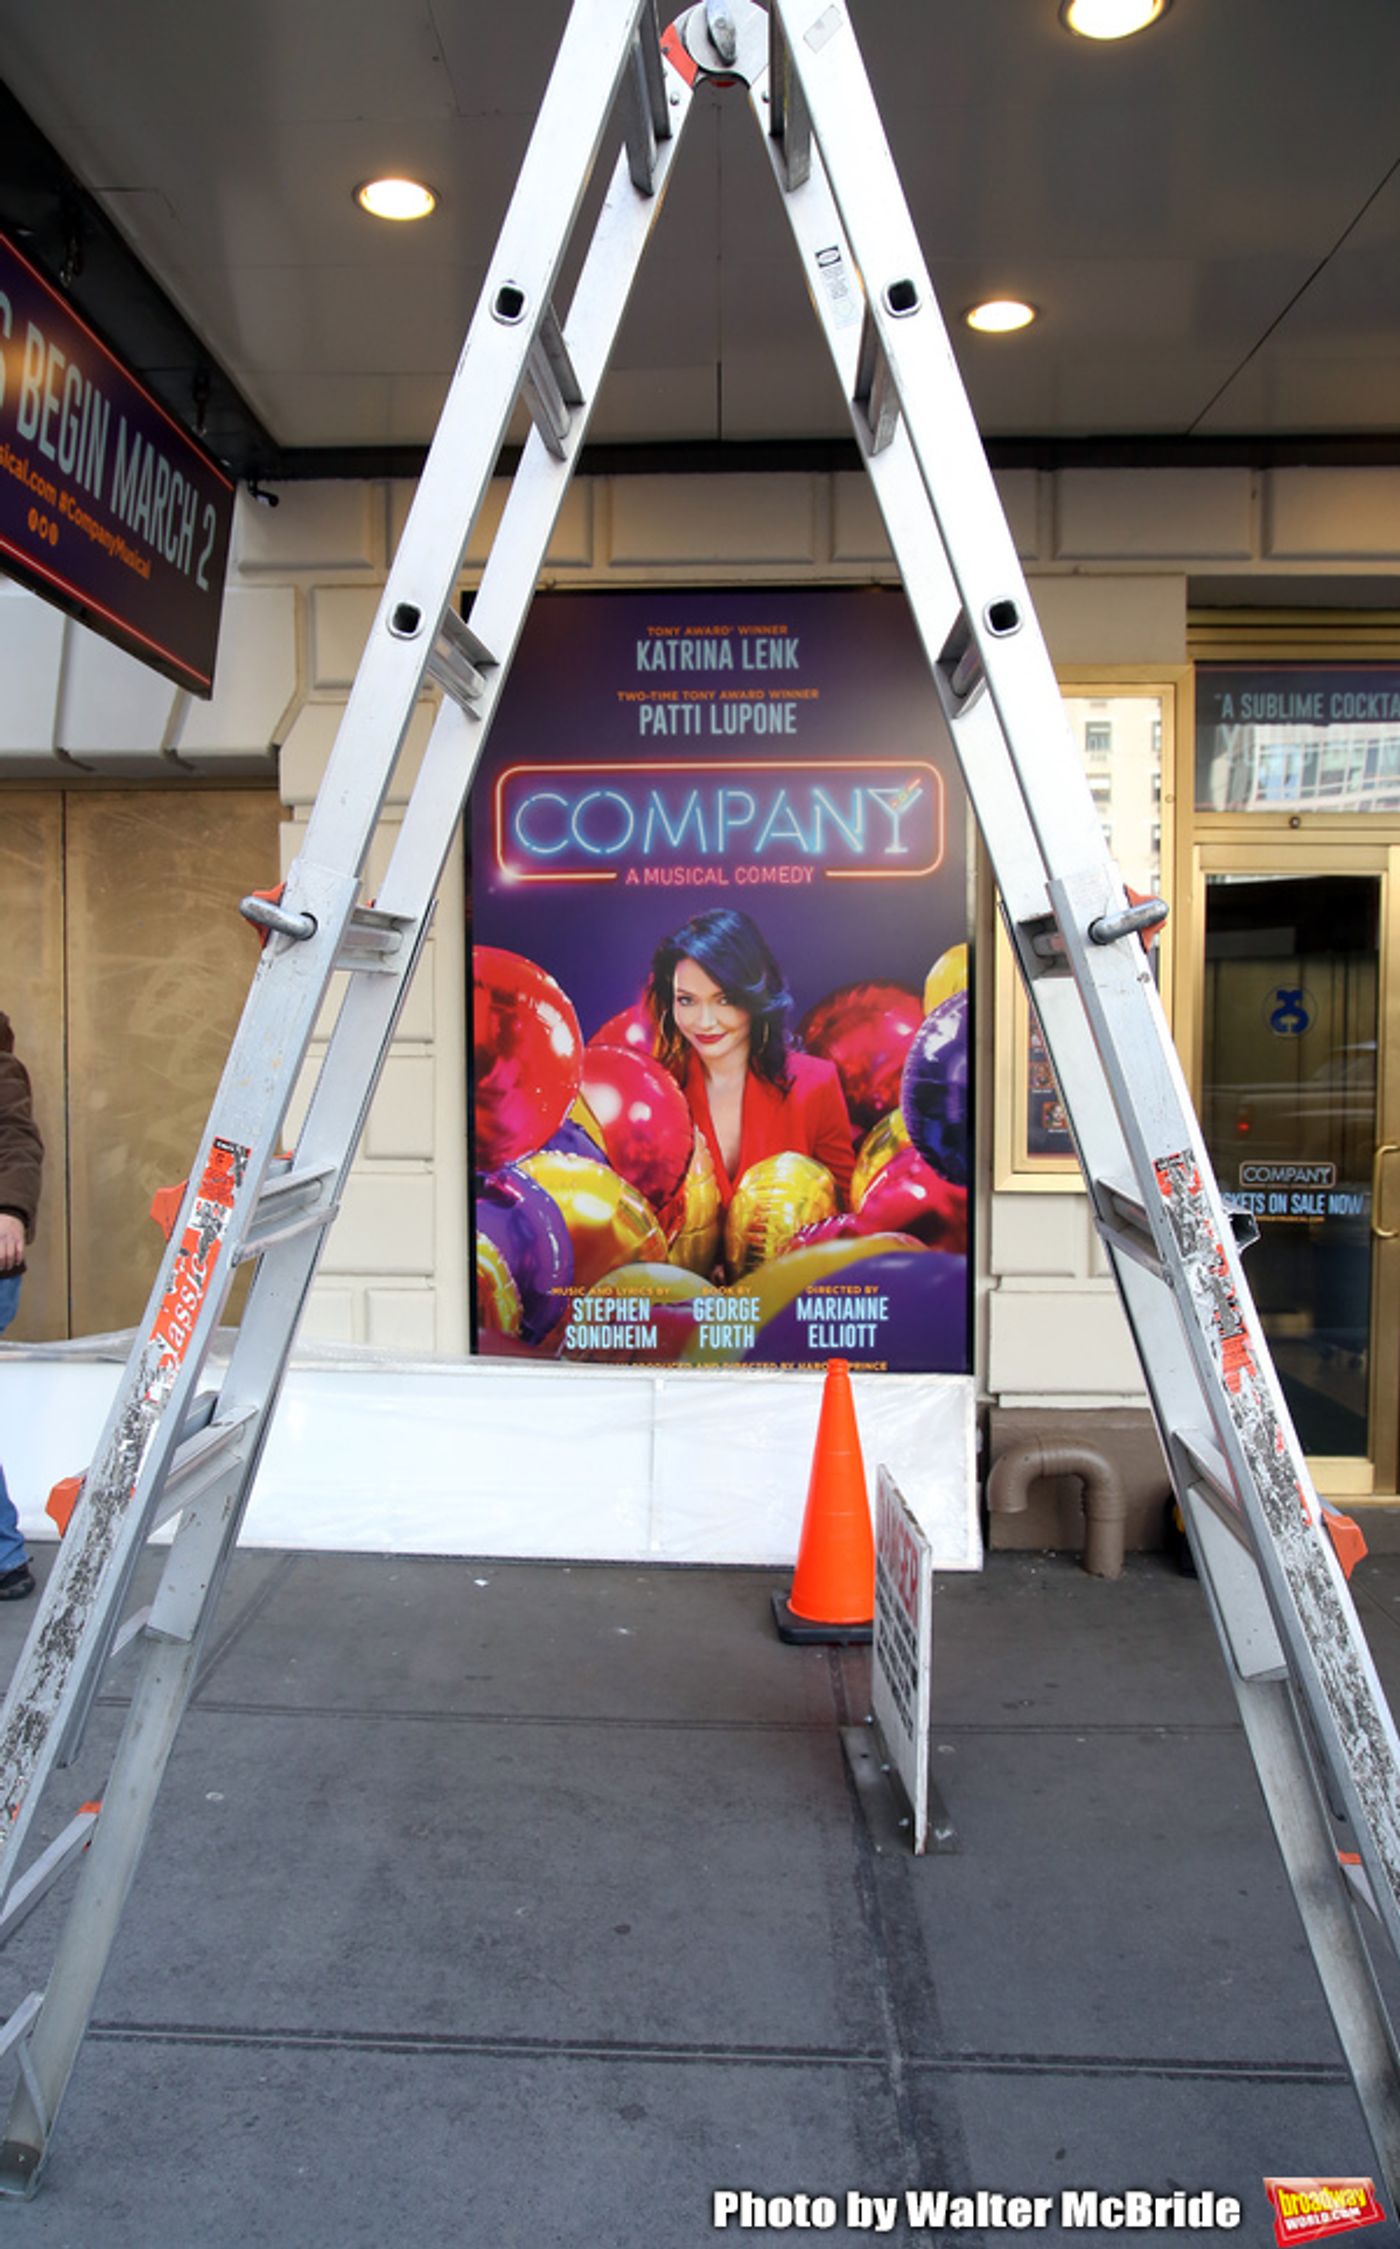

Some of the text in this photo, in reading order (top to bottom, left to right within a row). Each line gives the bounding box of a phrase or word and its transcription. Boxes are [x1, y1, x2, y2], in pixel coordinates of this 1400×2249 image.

[17, 321, 109, 500] BEGIN
[110, 415, 199, 575] MARCH
[196, 503, 217, 593] 2
[647, 626, 681, 637] TONY
[738, 624, 788, 635] WINNER
[636, 638, 799, 671] KATRINA LENK
[617, 688, 819, 701] TWO-TIME TONY AWARD WINNER
[1241, 693, 1324, 719] SUBLIME
[639, 703, 797, 735] PATTI LUPONE
[514, 781, 923, 855] COMPANY
[625, 865, 816, 886] A MUSICAL COMEDY
[1243, 1167, 1332, 1183] COMPANY
[1268, 1192, 1288, 1214] ON
[1291, 1192, 1325, 1214] SALE
[1328, 1193, 1365, 1215] NOW
[552, 1286, 671, 1296] MUSIC AND LYRICS BY
[737, 1286, 752, 1295] BY
[805, 1285, 880, 1295] DIRECTED BY
[572, 1297, 650, 1322] STEPHEN
[692, 1297, 761, 1322] GEORGE
[796, 1297, 889, 1321] MARIANNE
[565, 1324, 657, 1349] SONDHEIM
[699, 1324, 756, 1348] FURTH
[808, 1323, 878, 1348] ELLIOTT
